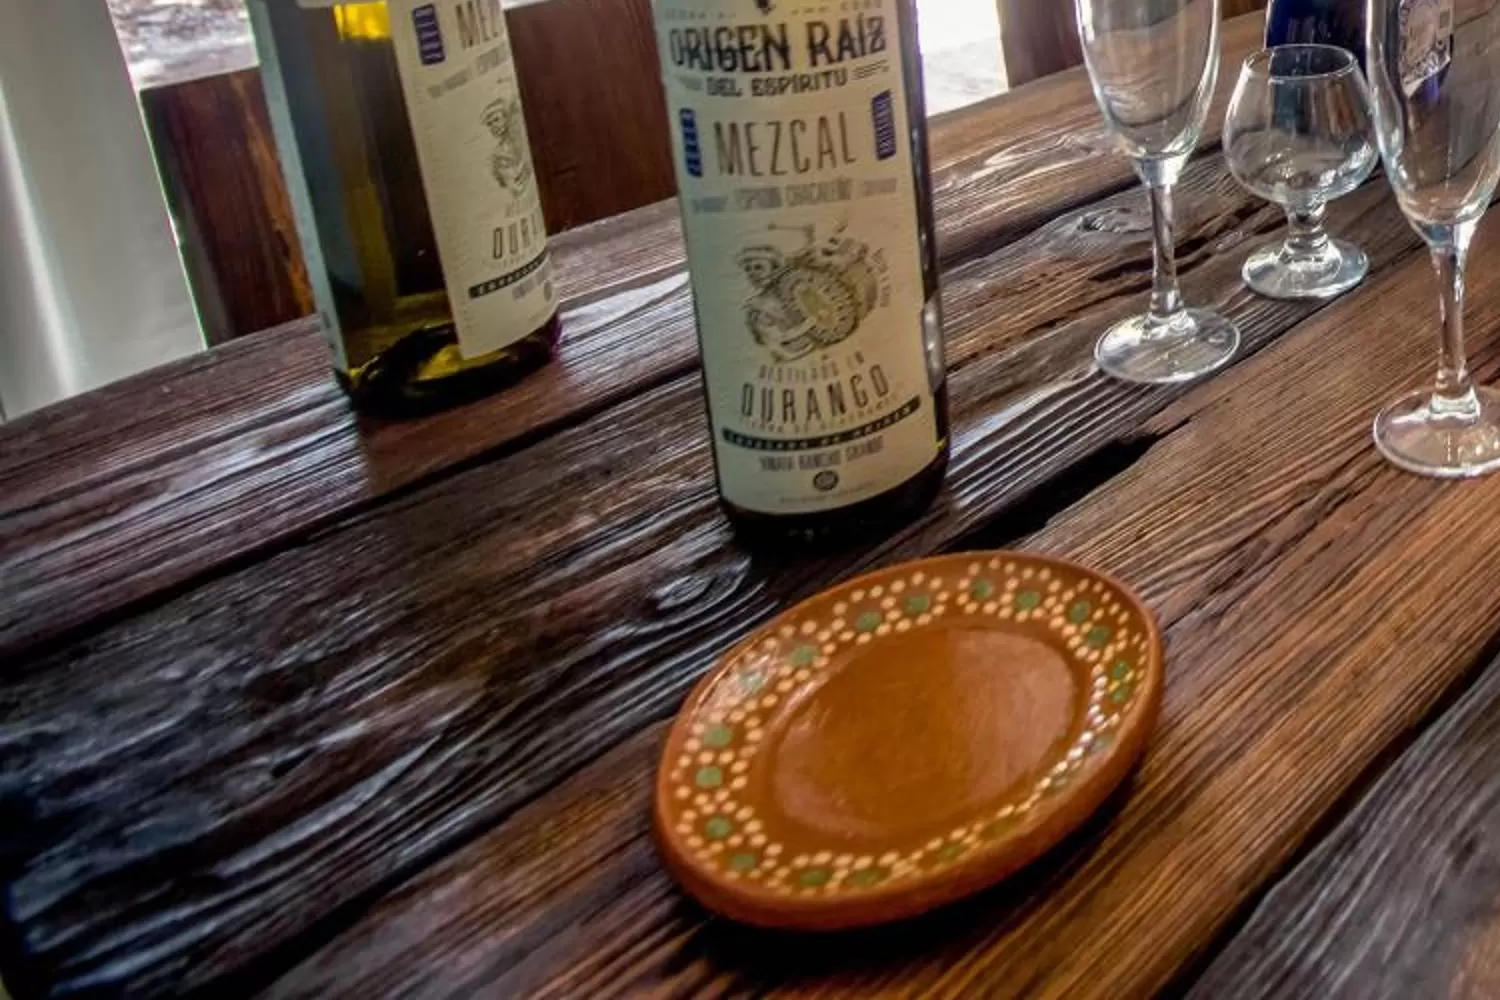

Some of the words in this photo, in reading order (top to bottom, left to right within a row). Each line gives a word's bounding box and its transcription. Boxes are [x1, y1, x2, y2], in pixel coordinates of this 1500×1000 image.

[668, 21, 791, 73] ORIGEN
[807, 12, 887, 68] RAÍZ
[706, 76, 743, 98] DEL
[713, 111, 857, 177] MEZCAL
[740, 364, 890, 424] DURANGO
